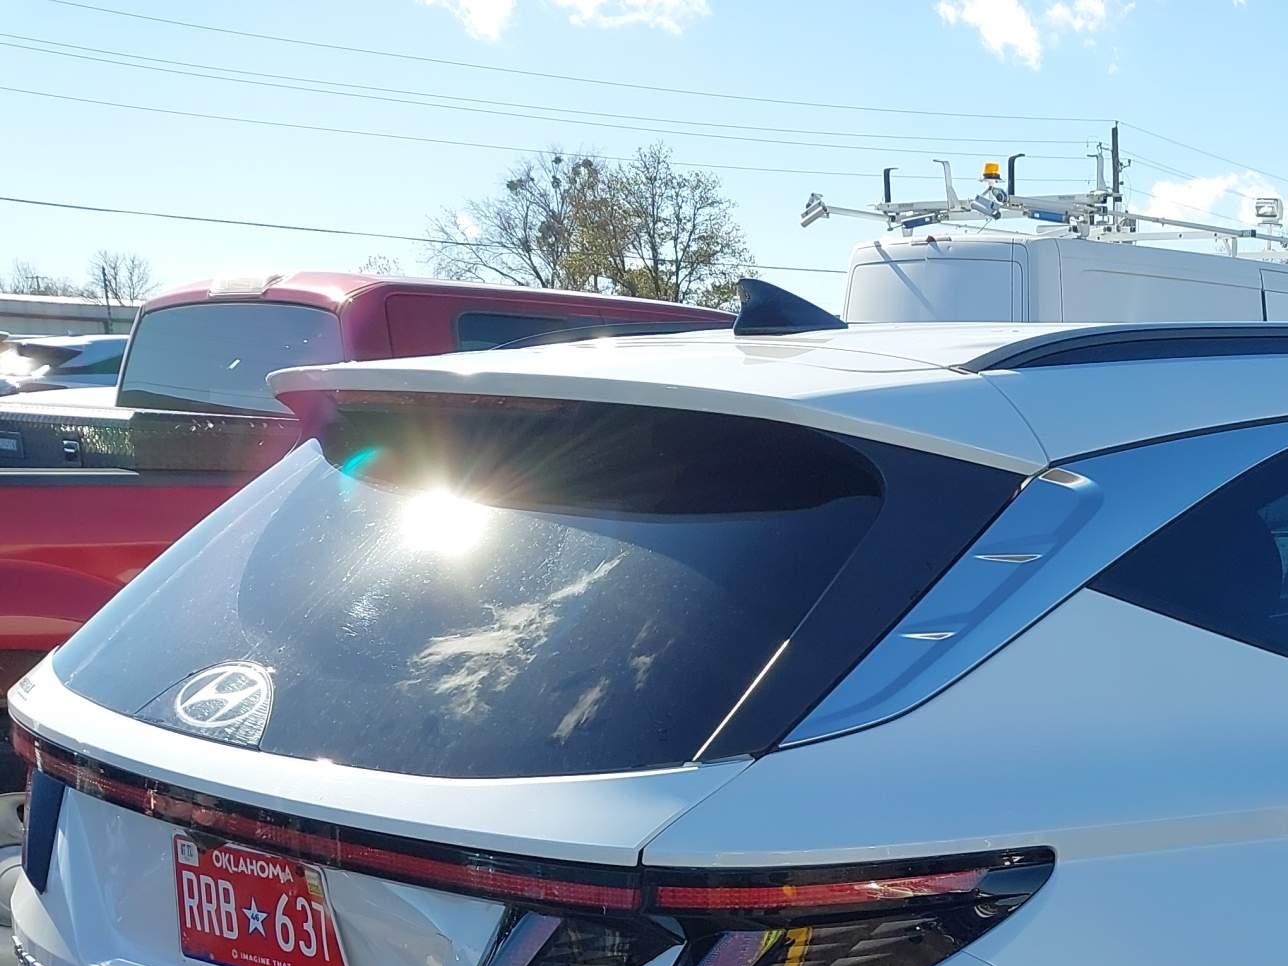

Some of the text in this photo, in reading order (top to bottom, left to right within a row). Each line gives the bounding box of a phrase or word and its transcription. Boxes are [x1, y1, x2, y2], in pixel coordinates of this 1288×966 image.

[212, 850, 294, 884] OKLAHOMA
[182, 870, 330, 961] RRB 637
[240, 952, 271, 966] IMAGINE
